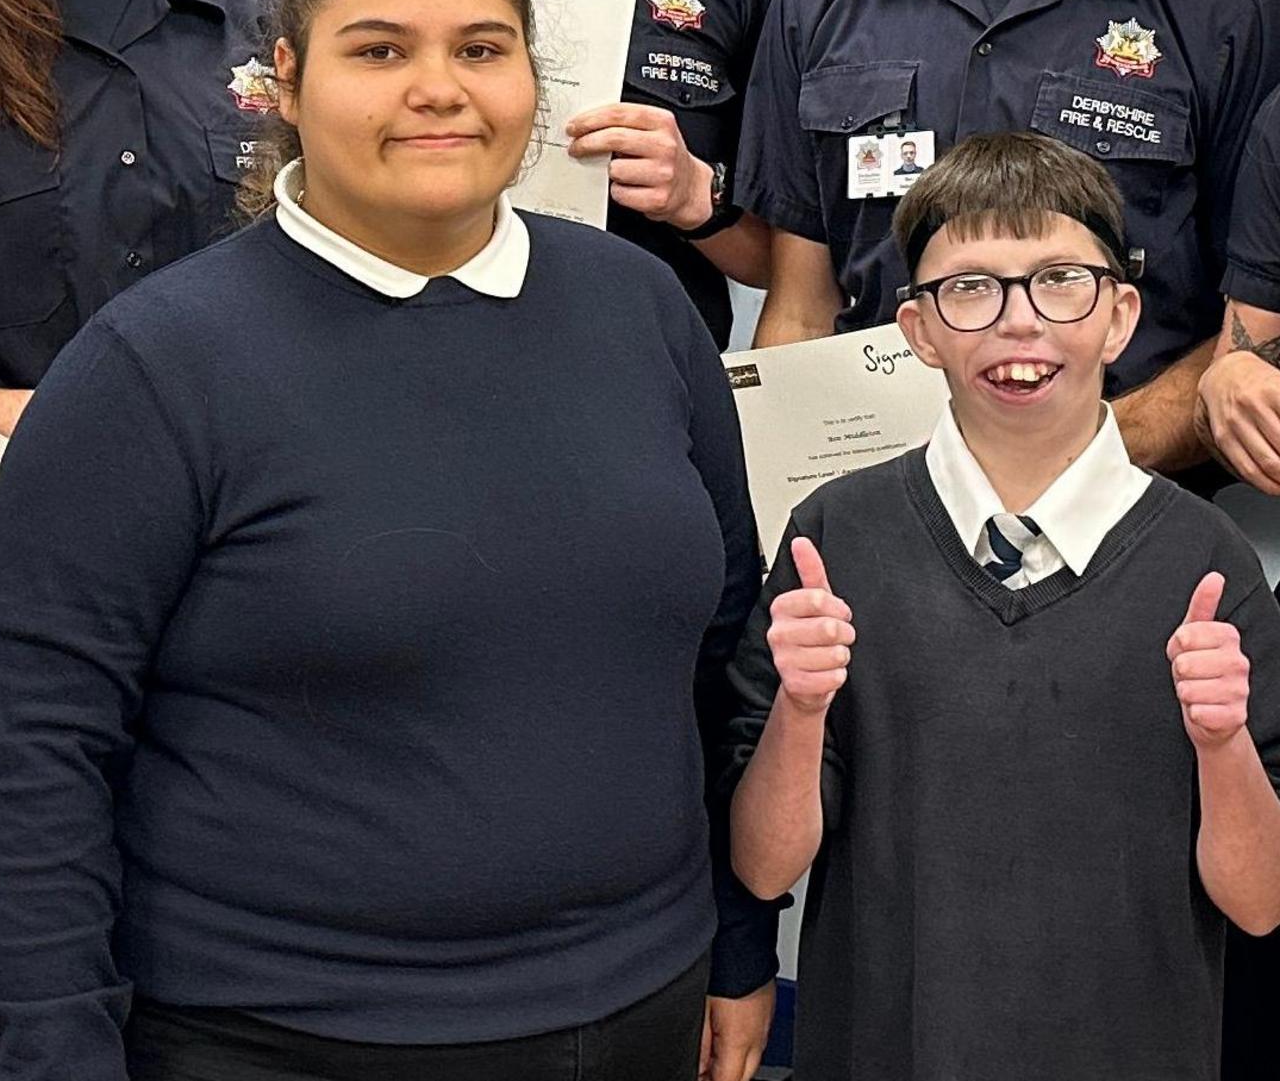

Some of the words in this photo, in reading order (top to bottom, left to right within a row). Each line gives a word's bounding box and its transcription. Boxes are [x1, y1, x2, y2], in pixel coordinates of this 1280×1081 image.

[641, 66, 669, 81] FIRE
[670, 69, 678, 82] &
[680, 70, 719, 93] RESCUE
[648, 52, 713, 77] DERBYSHIRE
[1059, 109, 1091, 127] FIRE
[1092, 115, 1103, 132] &
[1106, 118, 1162, 144] RESCUE
[1072, 95, 1155, 127] DERBYSHIRE
[862, 344, 913, 375] Signa
